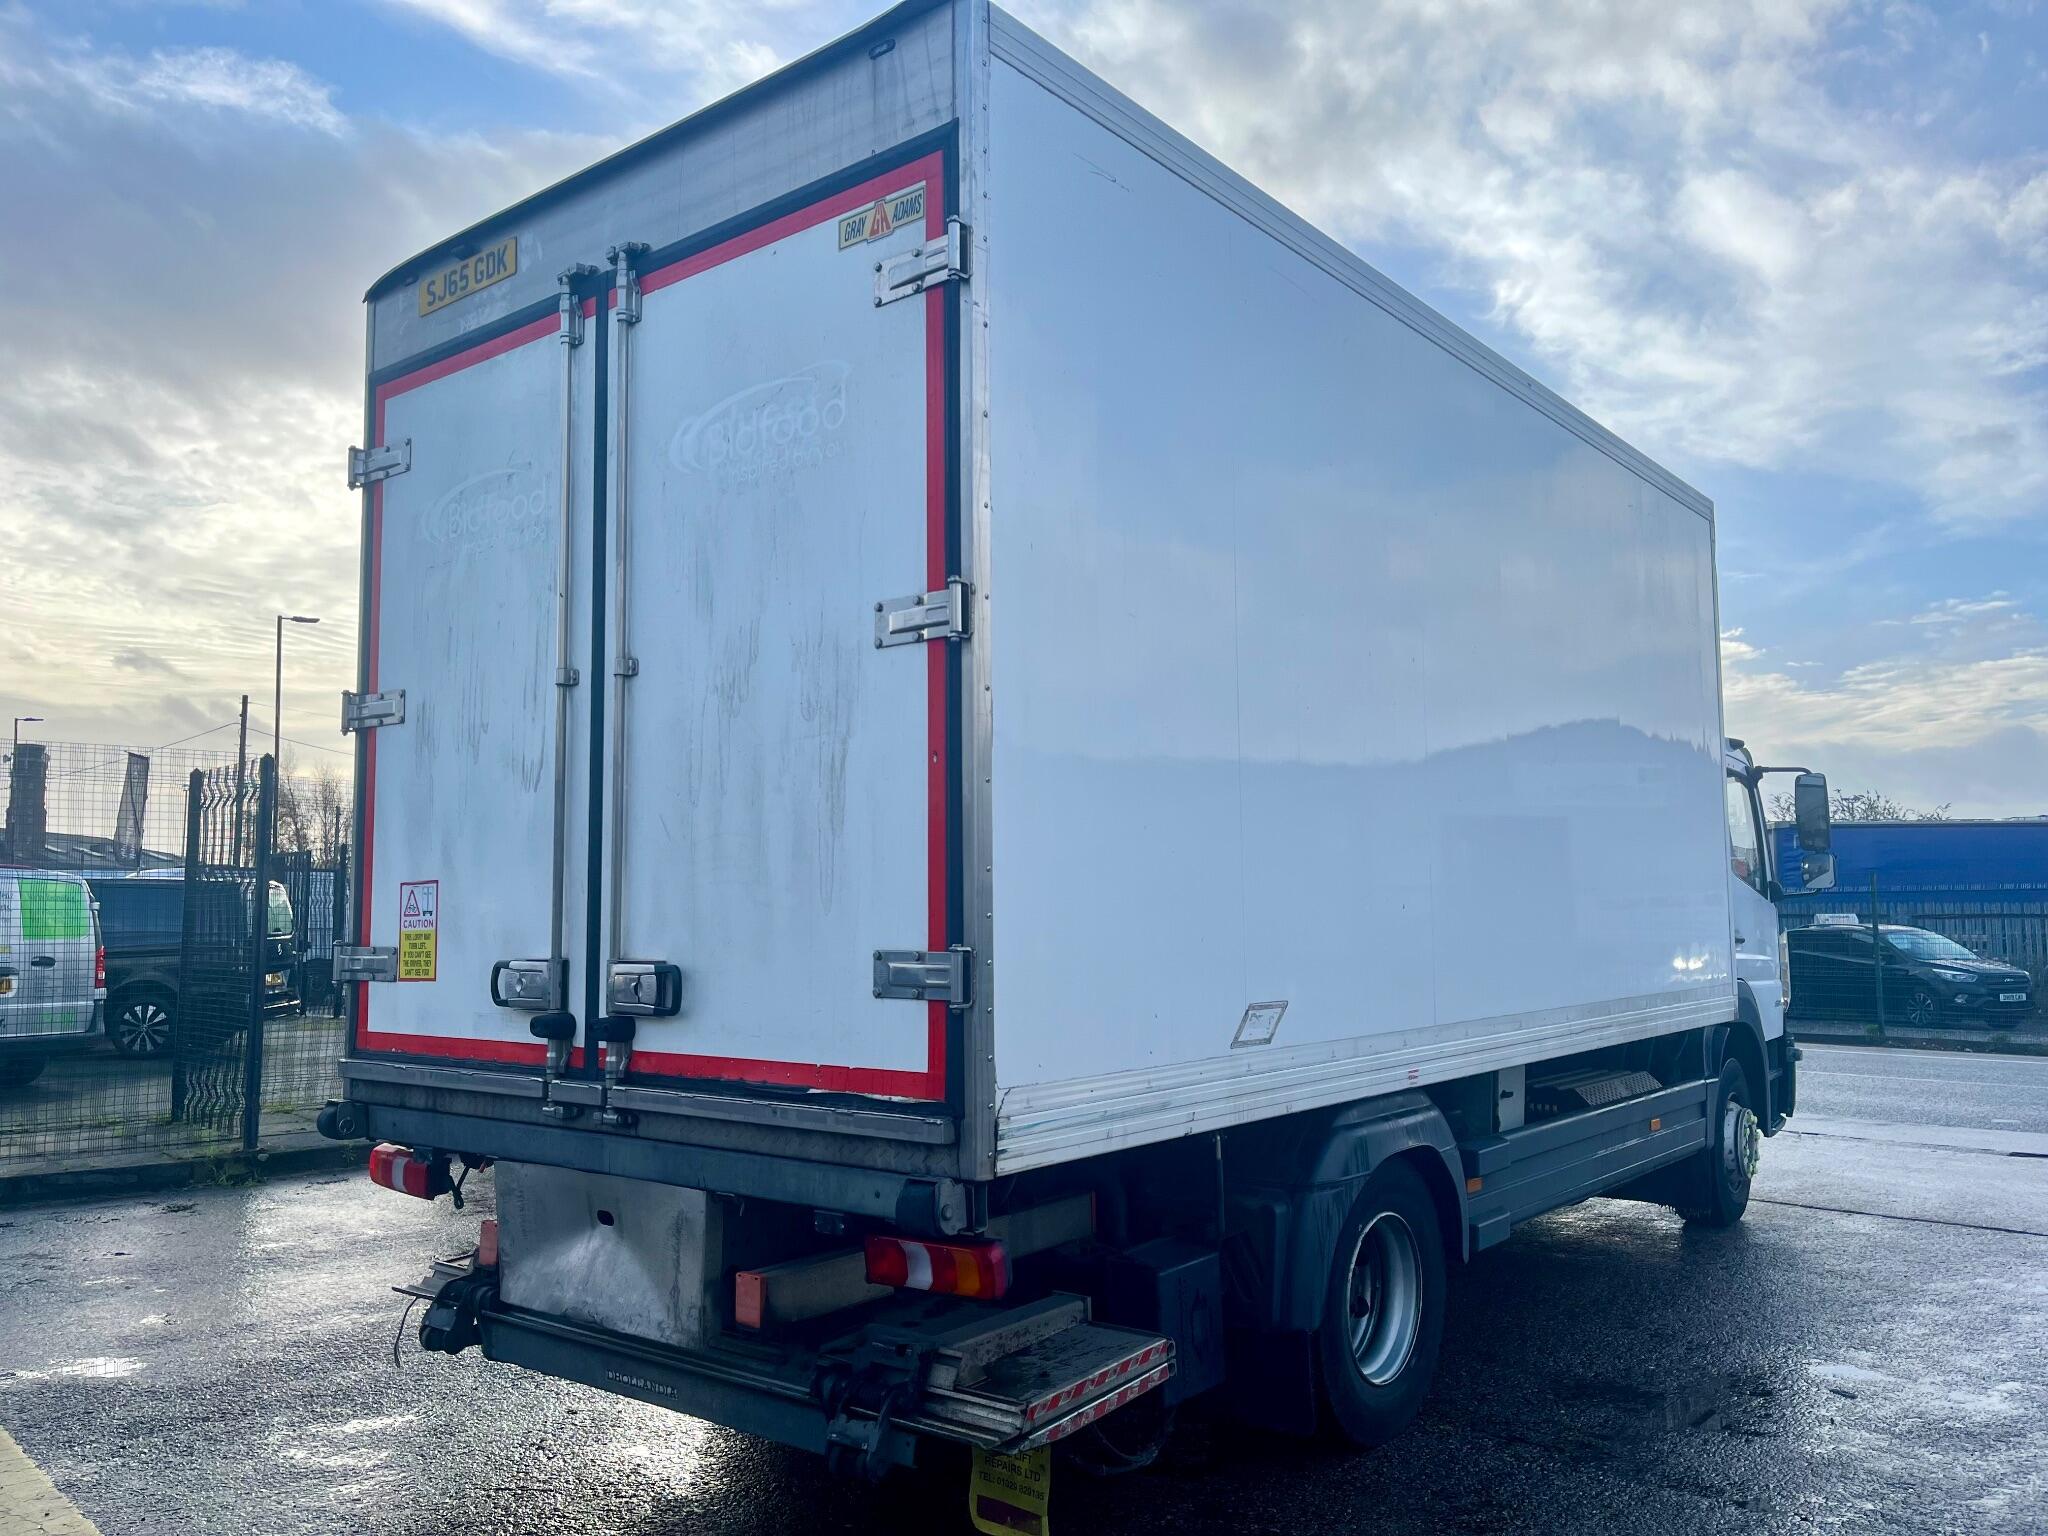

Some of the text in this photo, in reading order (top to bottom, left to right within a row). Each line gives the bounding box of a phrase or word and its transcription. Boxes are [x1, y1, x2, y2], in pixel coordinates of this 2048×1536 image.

[844, 216, 867, 242] GRAY
[891, 193, 923, 223] ADAMS
[426, 243, 508, 307] SJ65 GDK
[403, 919, 434, 929] CAUTION
[984, 1456, 1041, 1482] REPAIRS LTD
[1014, 1452, 1032, 1465] LIFT
